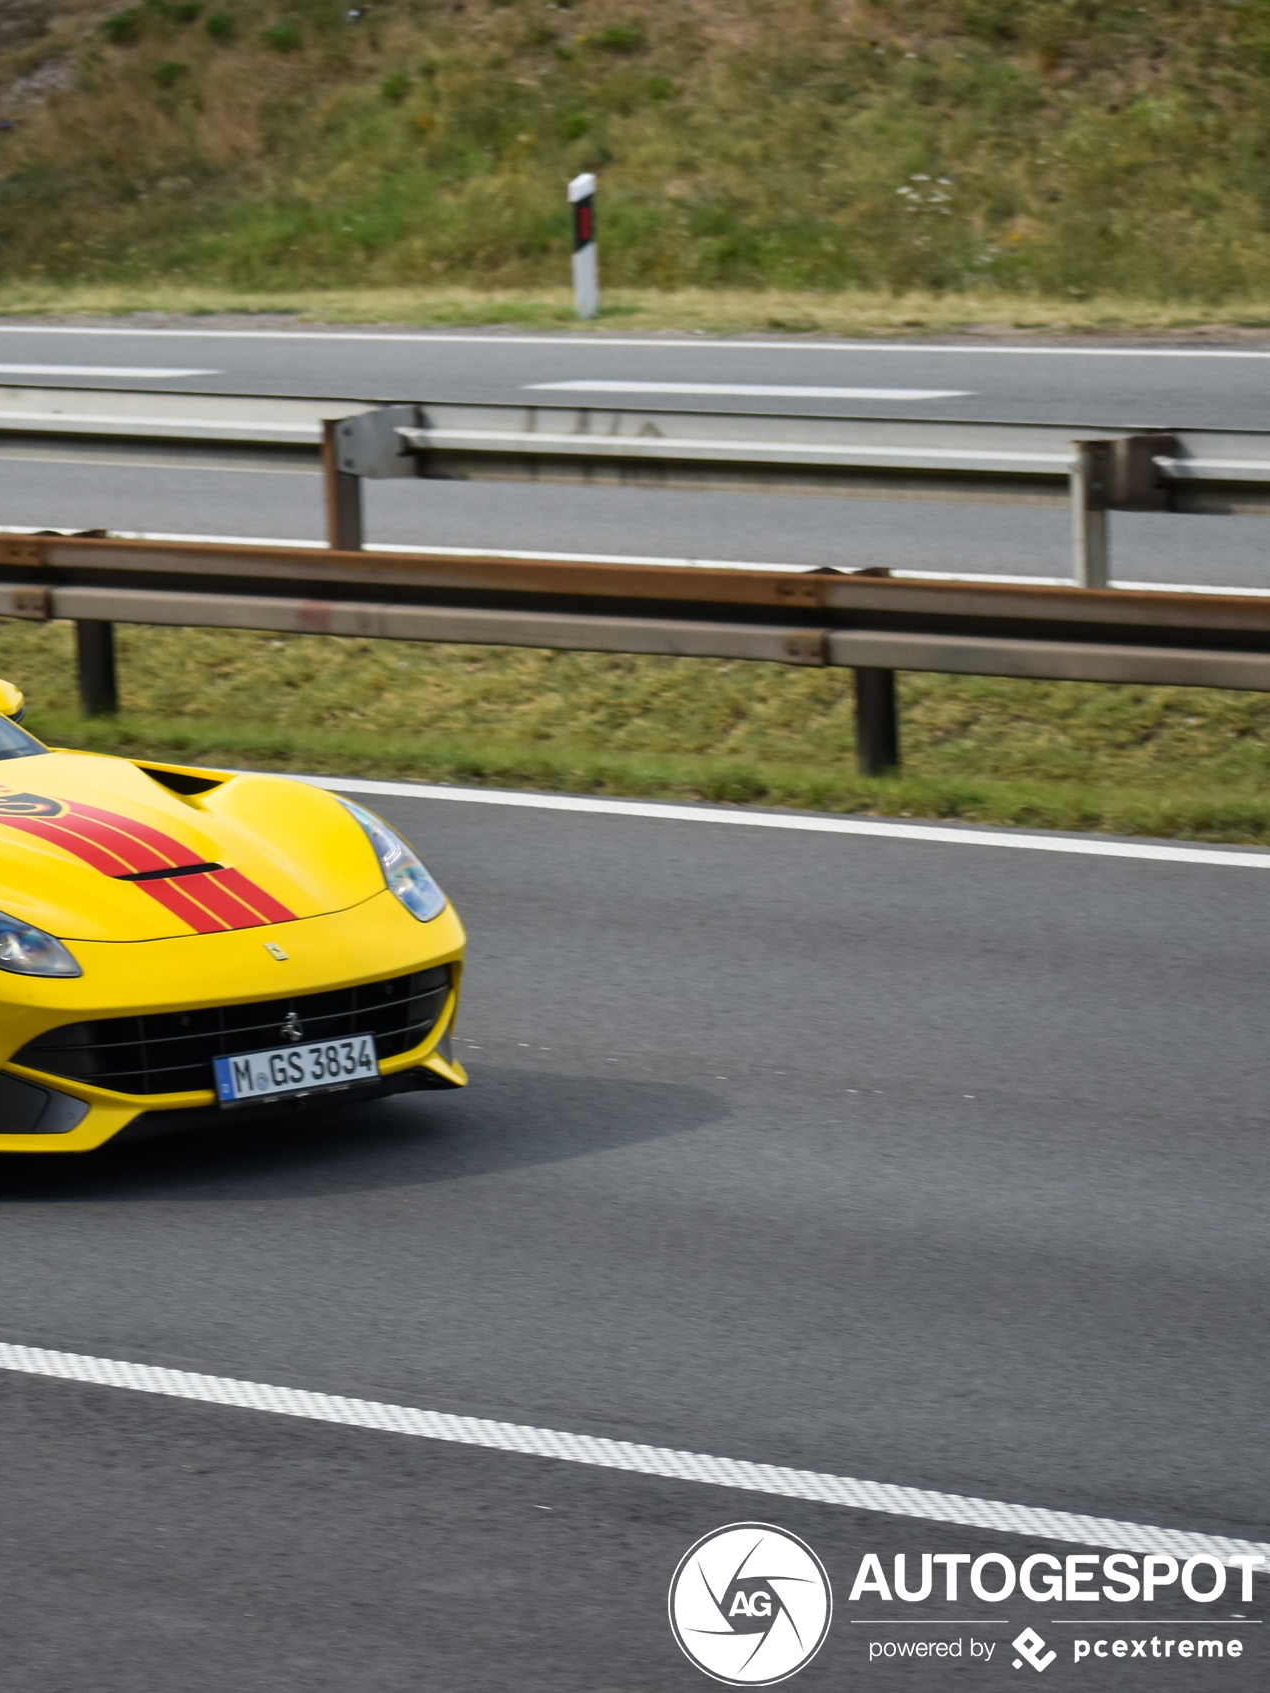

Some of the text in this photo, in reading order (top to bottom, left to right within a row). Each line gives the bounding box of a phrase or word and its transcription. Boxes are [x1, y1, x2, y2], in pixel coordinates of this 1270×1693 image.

[233, 1040, 372, 1093] M GS 3834
